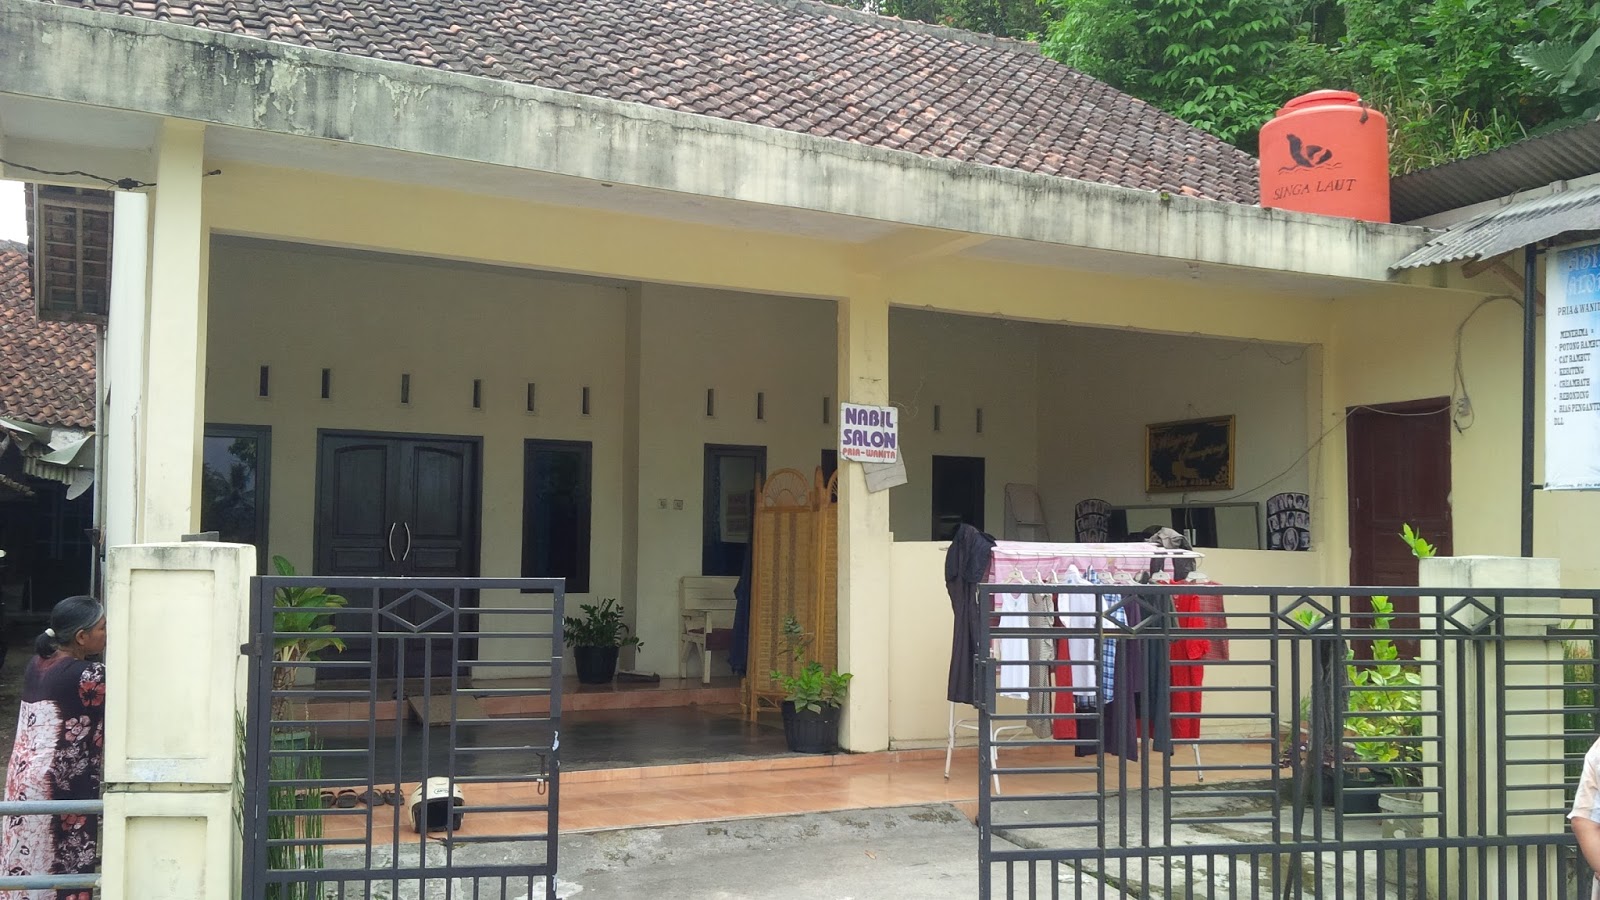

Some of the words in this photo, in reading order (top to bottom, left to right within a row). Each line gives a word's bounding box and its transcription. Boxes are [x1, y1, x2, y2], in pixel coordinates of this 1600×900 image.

[1273, 184, 1310, 200] SINGA
[1316, 179, 1357, 192] LAUT
[1558, 305, 1573, 316] PRIA
[1574, 305, 1579, 314] &
[1580, 302, 1600, 313] WANIT
[1559, 342, 1579, 351] POTONG
[1581, 339, 1600, 349] RAMBU
[1559, 355, 1568, 363] CAT
[1569, 353, 1590, 362] RAMBUT
[1572, 402, 1600, 412] PENGANTI
[845, 408, 894, 428] NABIL
[843, 429, 896, 449] SALON
